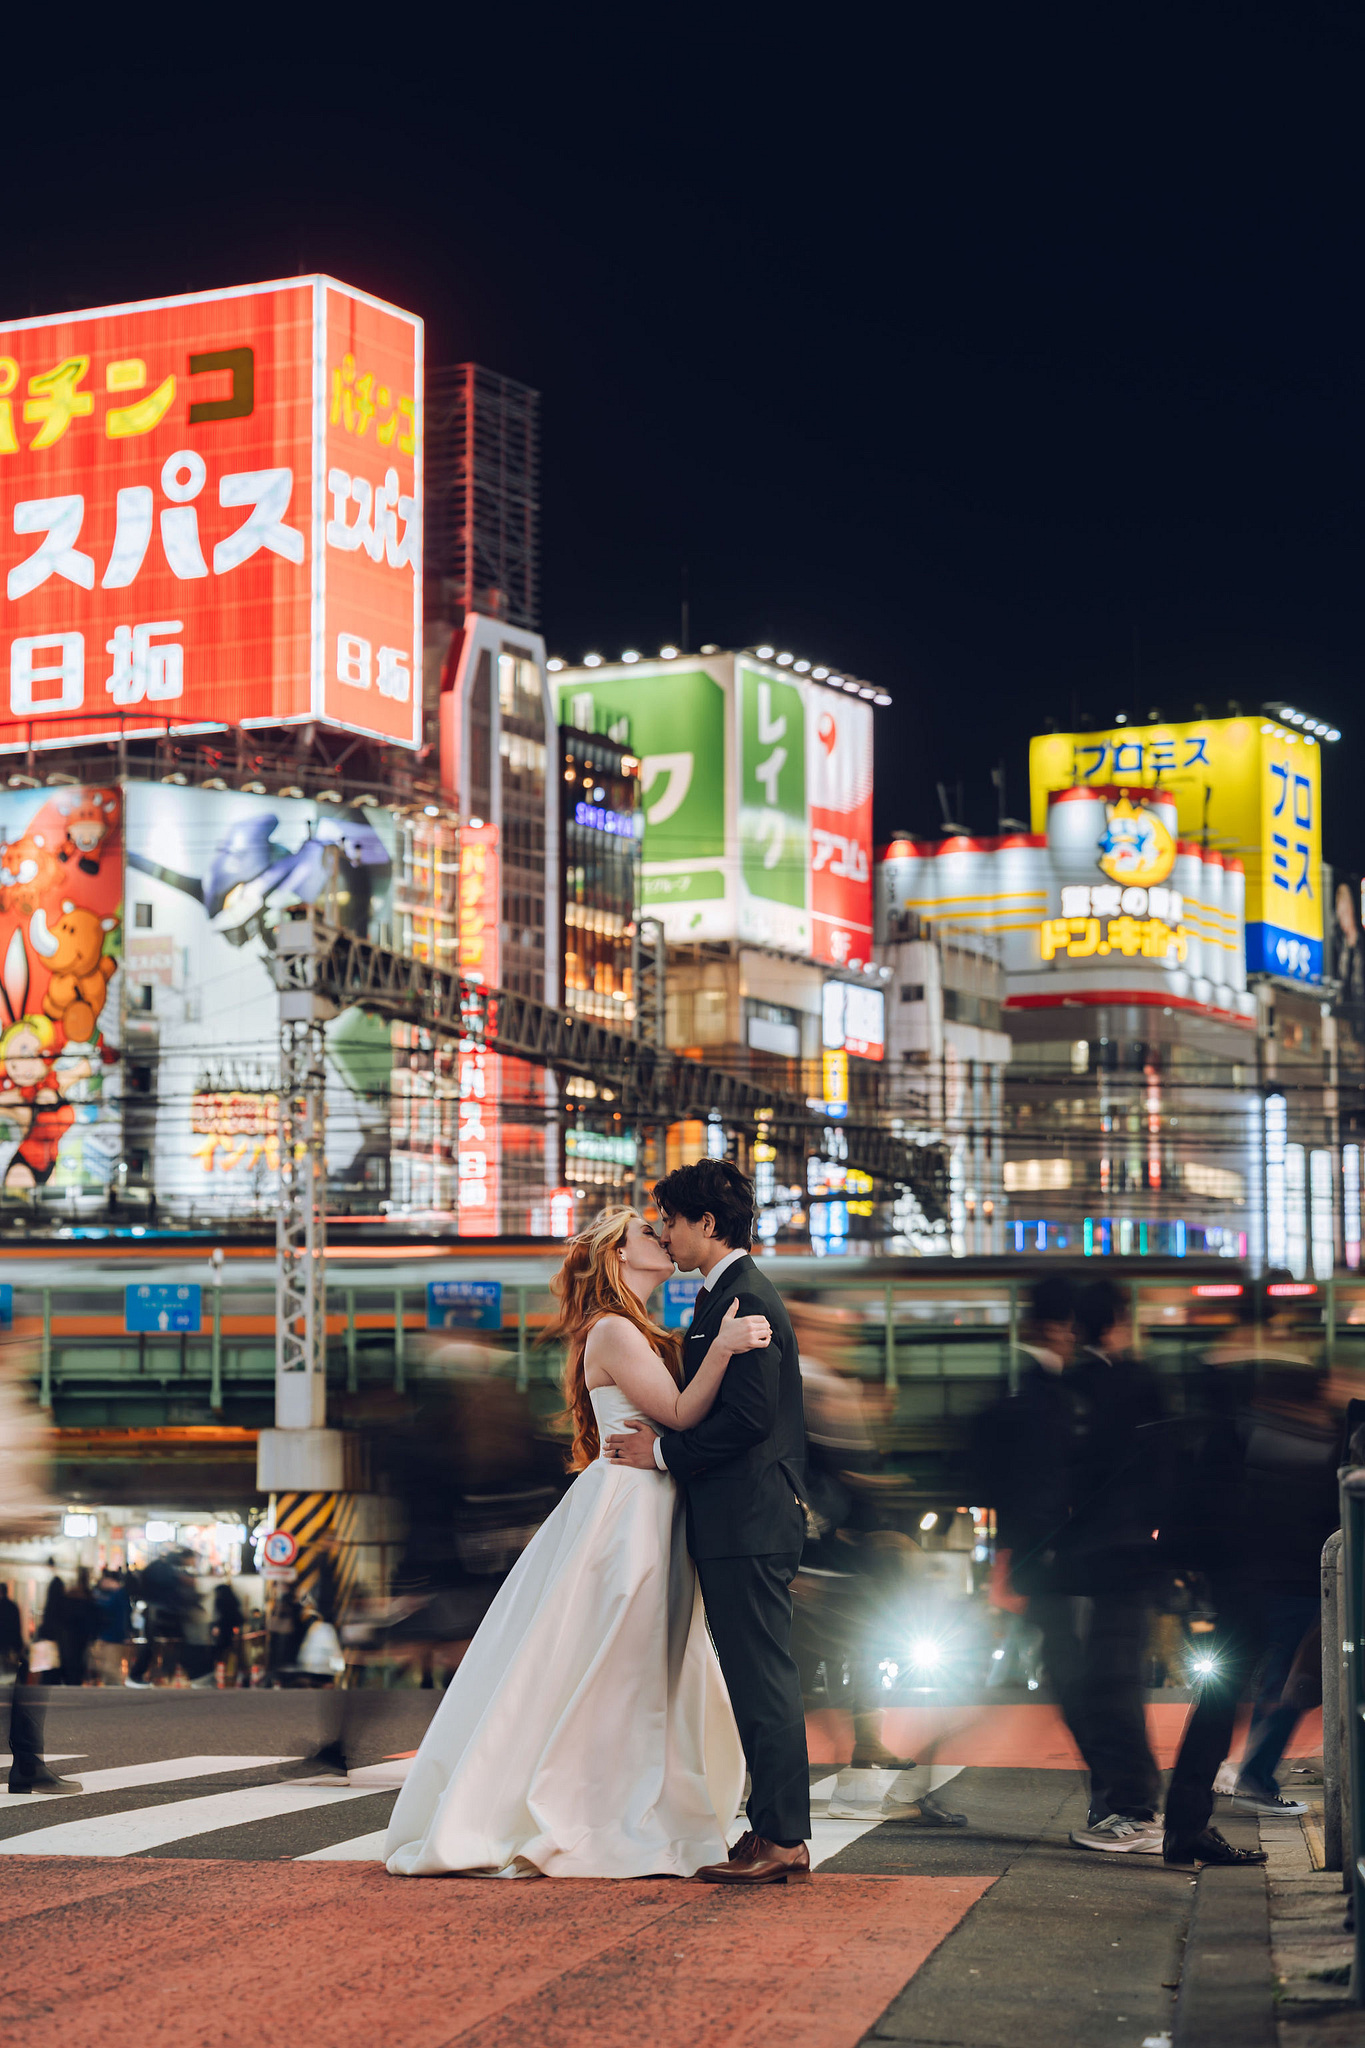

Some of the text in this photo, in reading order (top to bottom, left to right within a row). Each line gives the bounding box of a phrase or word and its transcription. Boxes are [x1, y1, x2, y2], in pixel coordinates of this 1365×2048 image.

[0, 346, 254, 455] チンコ
[10, 619, 184, 716] 日拓
[755, 681, 789, 870] レイク
[812, 828, 869, 883] アコム
